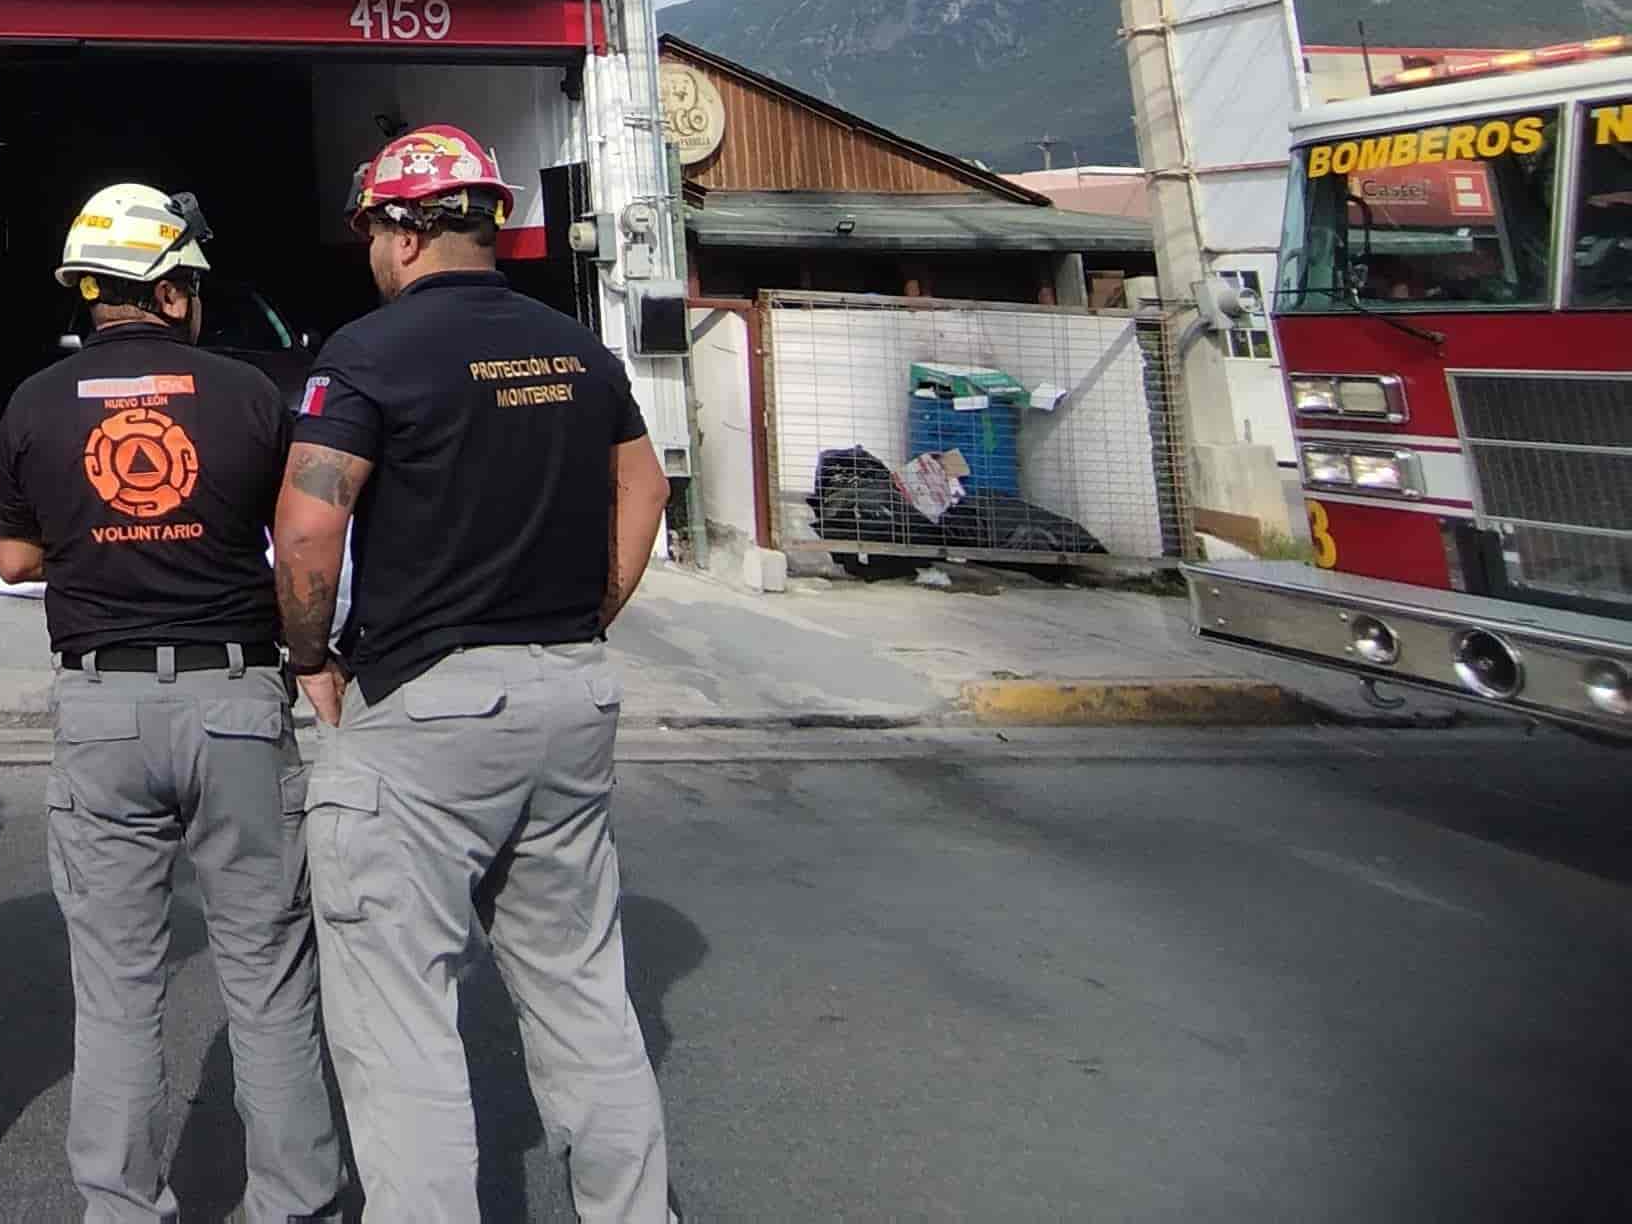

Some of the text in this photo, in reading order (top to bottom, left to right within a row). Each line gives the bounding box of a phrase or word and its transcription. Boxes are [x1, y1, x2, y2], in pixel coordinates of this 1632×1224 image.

[1307, 116, 1544, 179] BOMBEROS
[496, 384, 574, 407] MONTERREY
[91, 523, 203, 543] VOLUNTARIO
